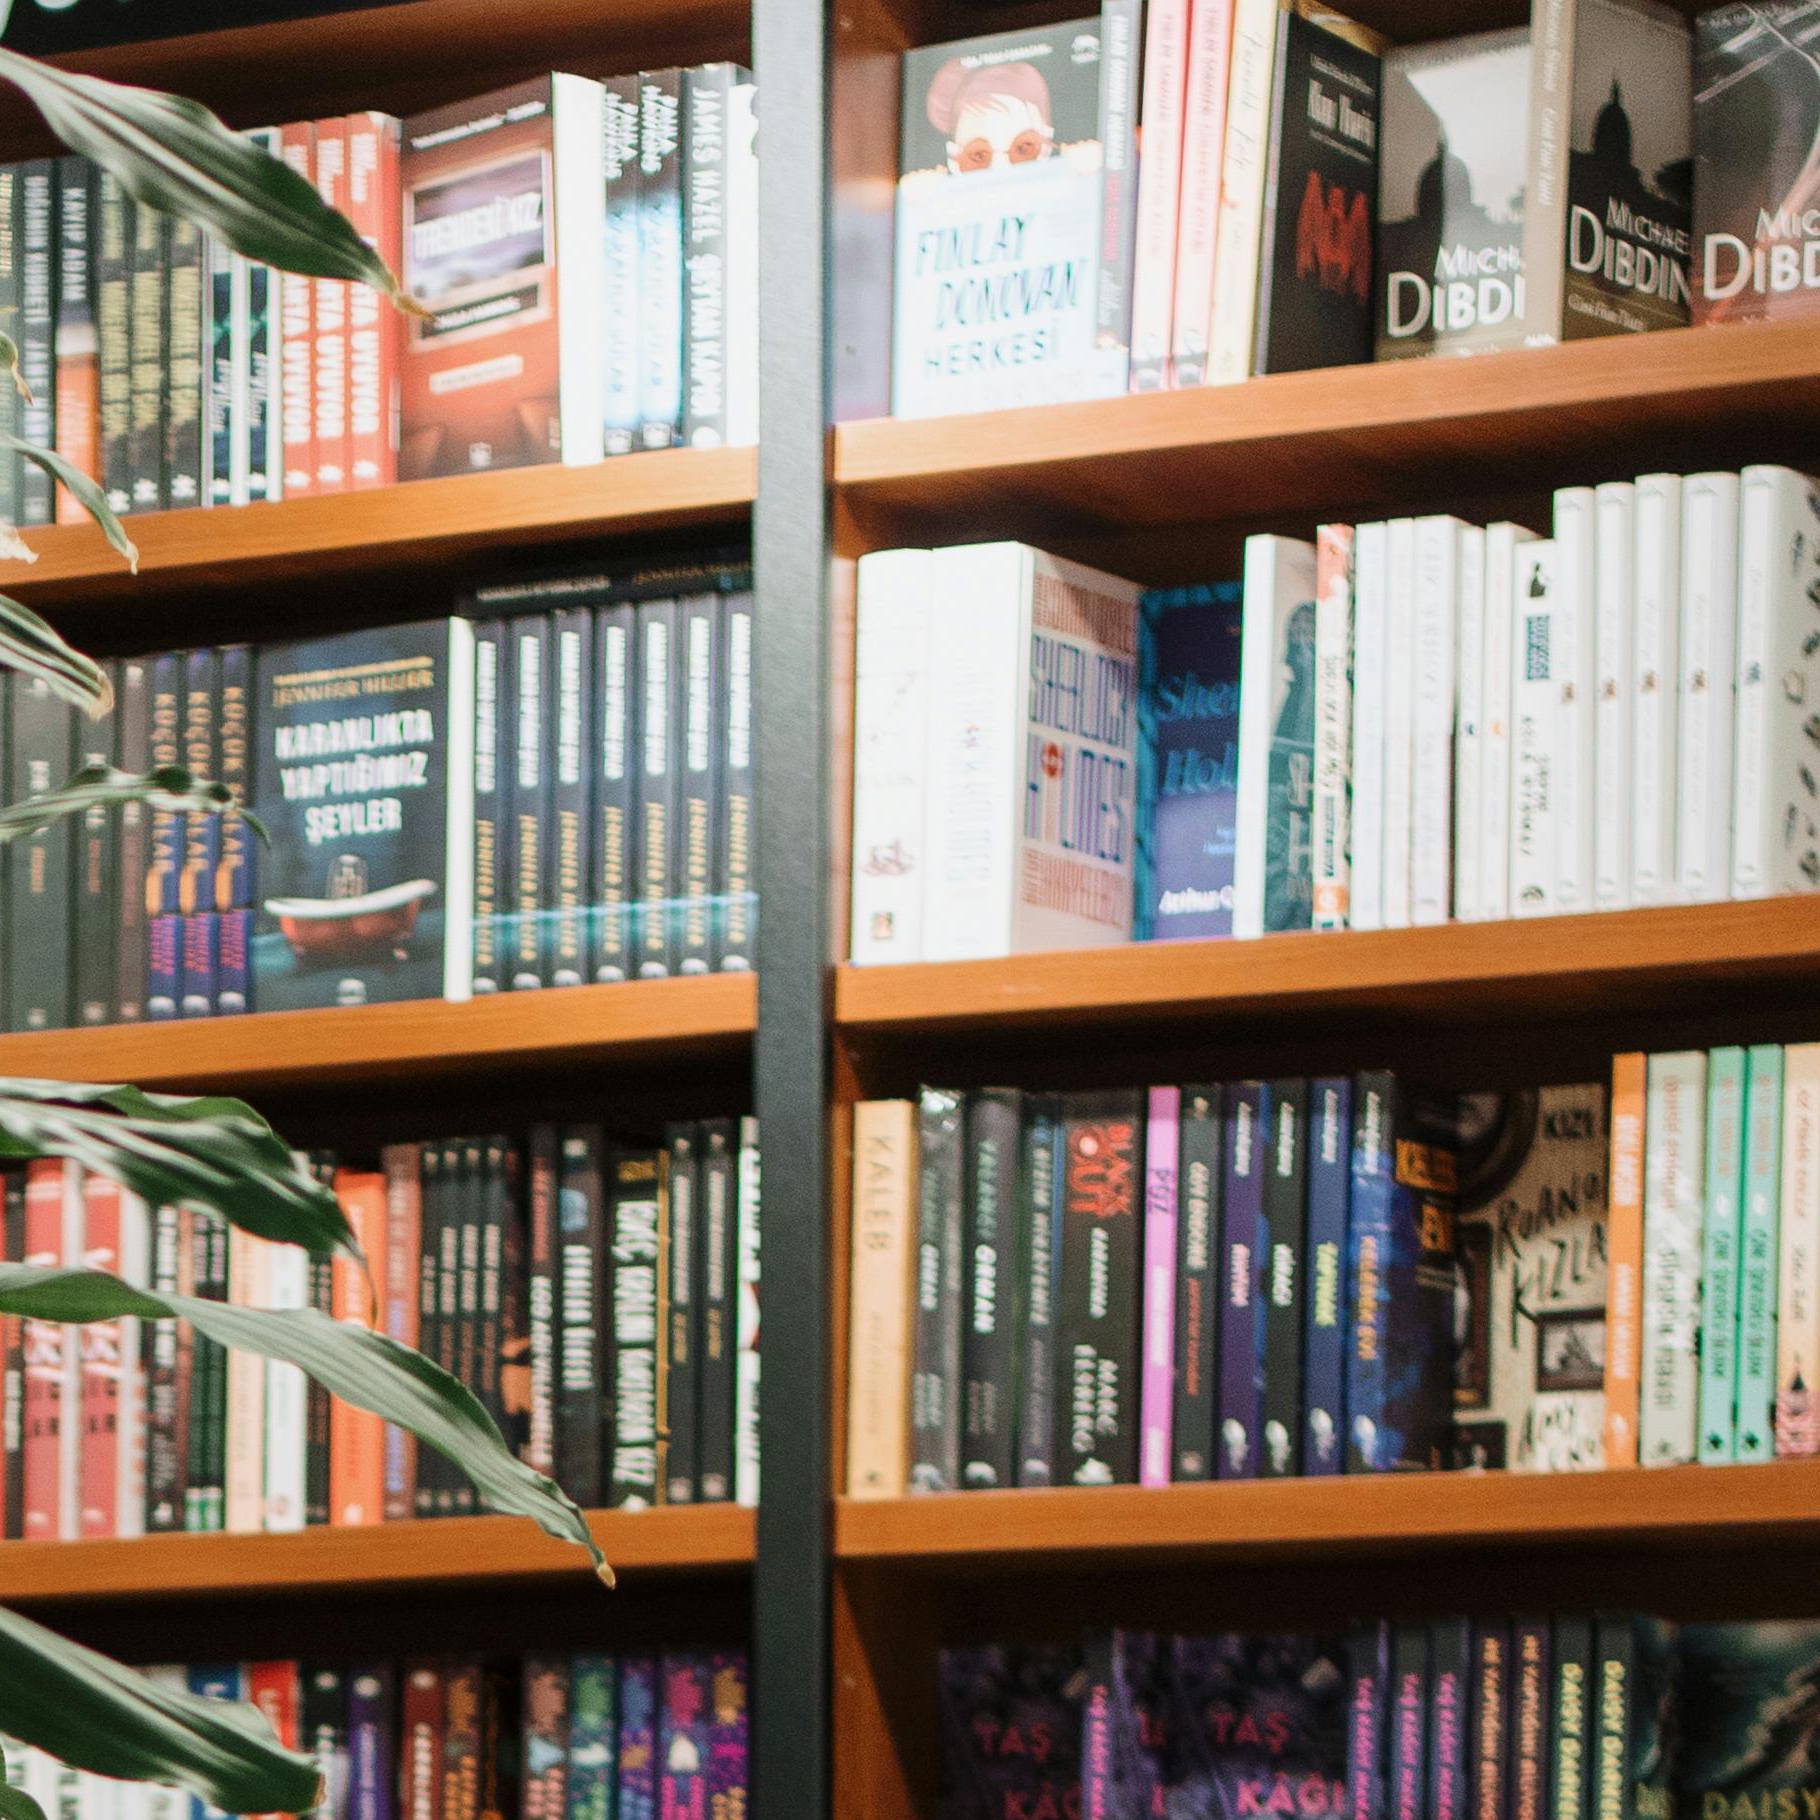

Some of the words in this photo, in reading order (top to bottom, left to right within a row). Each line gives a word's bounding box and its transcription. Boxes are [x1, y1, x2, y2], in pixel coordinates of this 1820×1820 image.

[916, 215, 1033, 277] FINLAY
[1606, 195, 1689, 254] MICHAE
[1756, 206, 1820, 241] MIC
[1434, 243, 1525, 280] MICH
[937, 258, 1088, 330] DONOVAN
[1387, 271, 1525, 338] DIBDI
[1237, 1771, 1346, 1817] KÂĞI
